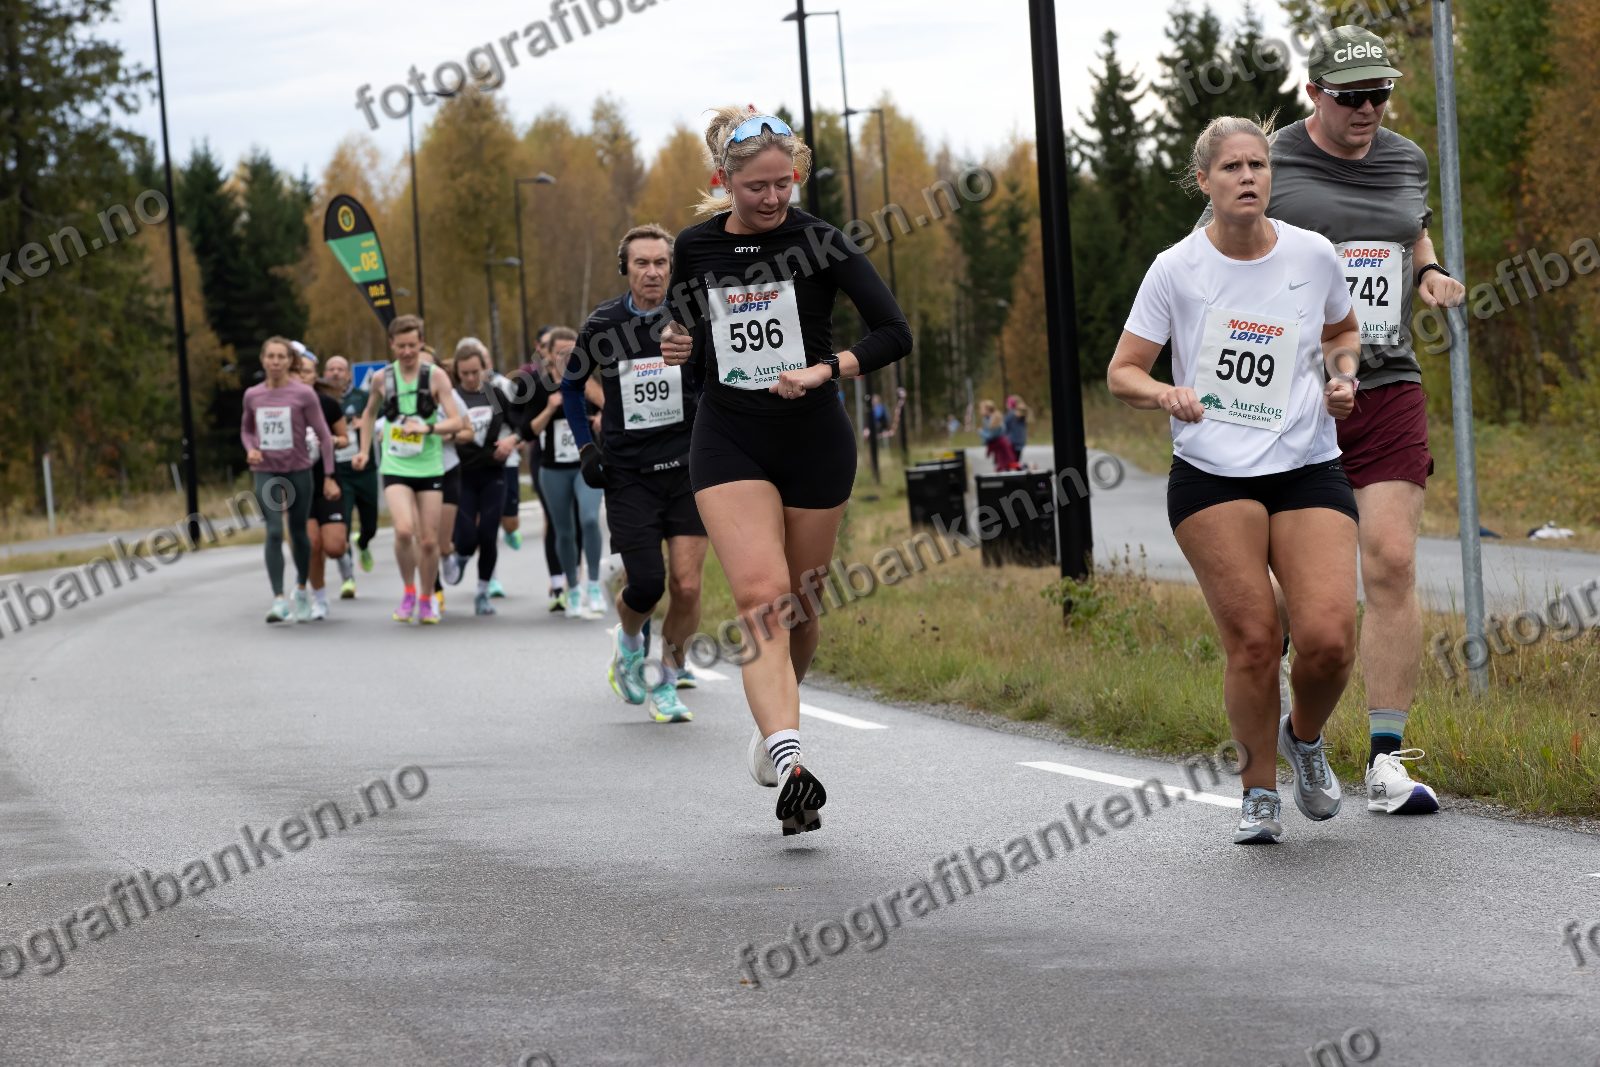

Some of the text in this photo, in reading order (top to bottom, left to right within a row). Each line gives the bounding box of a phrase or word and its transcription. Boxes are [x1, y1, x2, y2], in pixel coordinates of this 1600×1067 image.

[1333, 41, 1383, 63] ciele
[1343, 248, 1391, 259] NORGES
[1347, 258, 1384, 268] LØPET
[726, 290, 779, 304] NORGES
[1344, 275, 1389, 307] 742
[732, 301, 772, 314] LØPET
[1227, 319, 1285, 337] NORGES
[1361, 321, 1399, 335] Aurskog
[729, 318, 784, 353] 596
[1230, 330, 1274, 345] LØPET
[636, 368, 664, 378] LØPET
[753, 361, 804, 377] Aurskog
[1215, 348, 1275, 388] 509
[634, 379, 670, 404] 599
[1230, 398, 1283, 420] Aurskog
[1228, 410, 1272, 423] SPAREBANK
[262, 421, 285, 435] 975
[653, 460, 681, 471] SILVA
